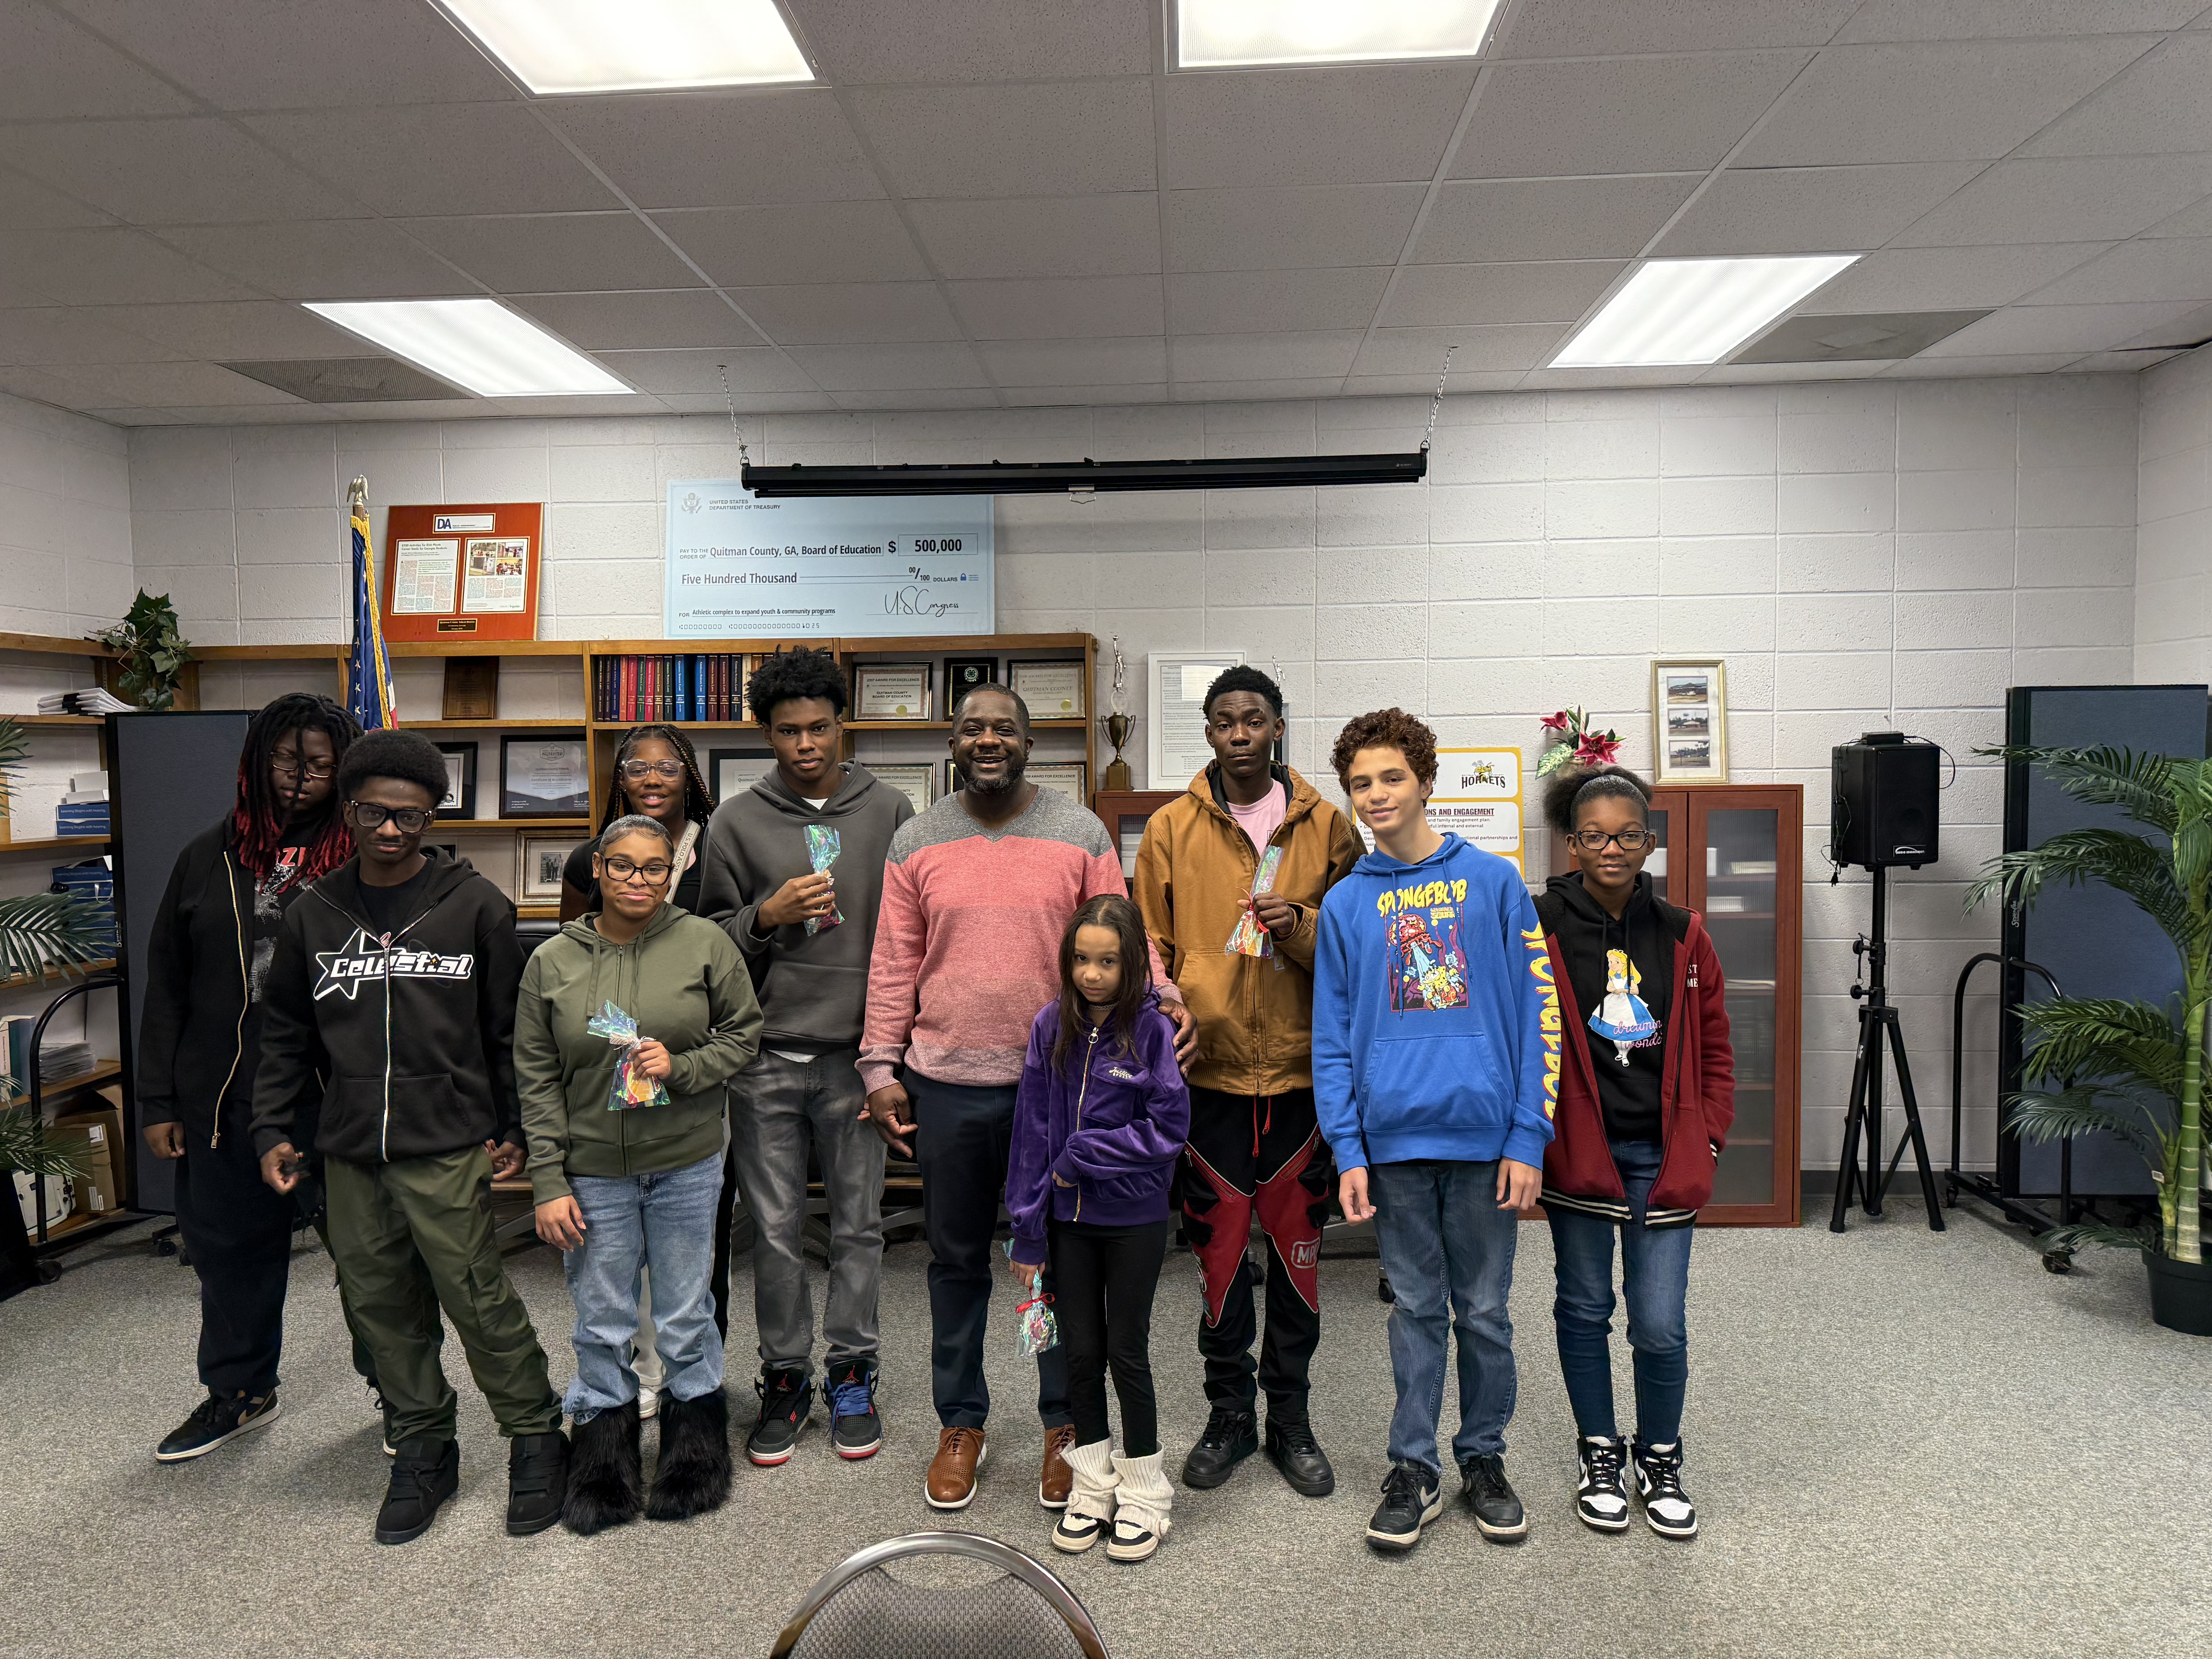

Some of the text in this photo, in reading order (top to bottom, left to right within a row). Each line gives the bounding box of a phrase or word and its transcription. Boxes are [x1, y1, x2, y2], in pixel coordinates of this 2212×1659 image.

[437, 518, 452, 529] DA
[710, 544, 881, 558] Quitman County, GA, Board of Education
[888, 539, 962, 554] $ 500,000
[682, 572, 797, 584] Five Hundred Thousand
[1613, 1020, 1662, 1035] dreamin
[1625, 1032, 1662, 1049] wonde
